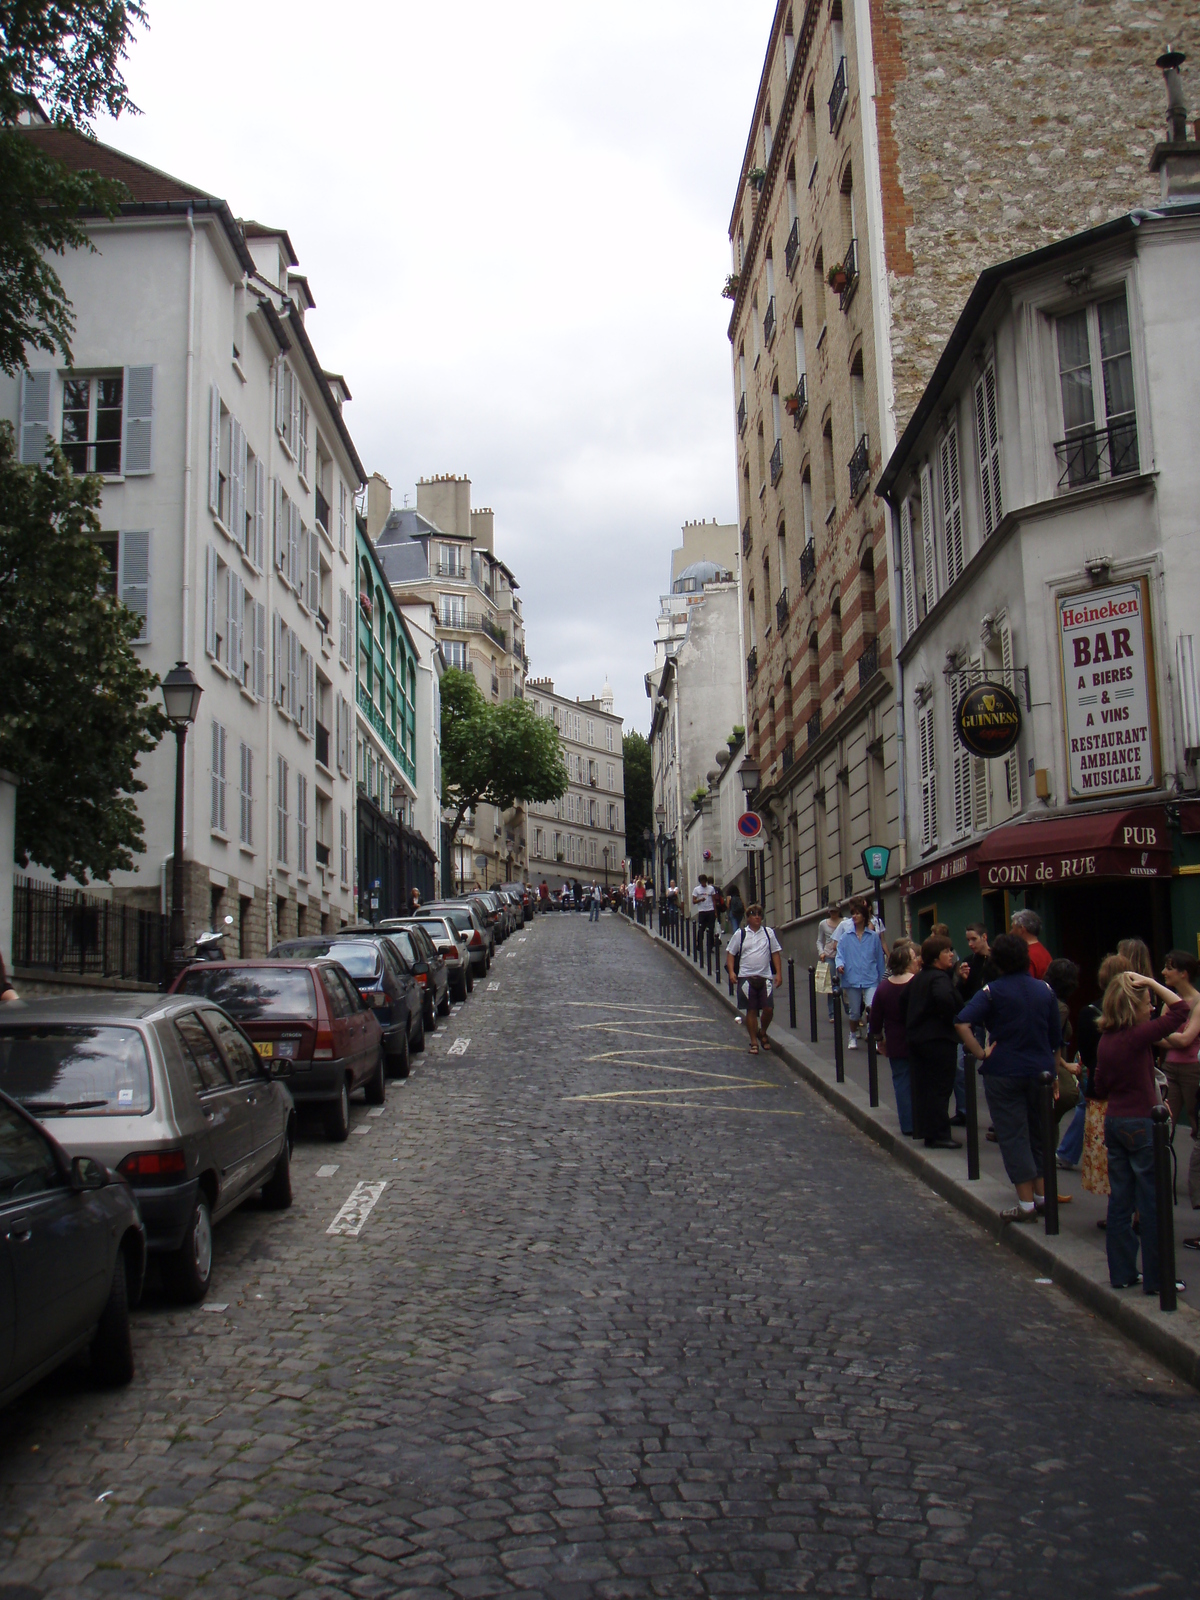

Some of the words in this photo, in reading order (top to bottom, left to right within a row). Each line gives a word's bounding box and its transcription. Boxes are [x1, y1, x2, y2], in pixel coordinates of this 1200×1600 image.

[1062, 600, 1138, 627] Heineken
[1072, 628, 1133, 668] BAR
[1078, 676, 1086, 689] A
[1092, 666, 1133, 686] BIERES
[1101, 691, 1110, 704] &
[961, 712, 1018, 728] GUINNESS
[1086, 713, 1094, 726] A
[1101, 706, 1129, 723] VINS
[1071, 727, 1147, 752] RESTAURANT
[1080, 747, 1141, 770] AMBIANCE
[1082, 766, 1141, 788] MUSICALE
[1123, 827, 1157, 845] PUB
[988, 864, 1028, 884] COIN
[1035, 862, 1053, 880] de
[1060, 856, 1096, 878] RUE
[1130, 867, 1157, 875] GUINNESS
